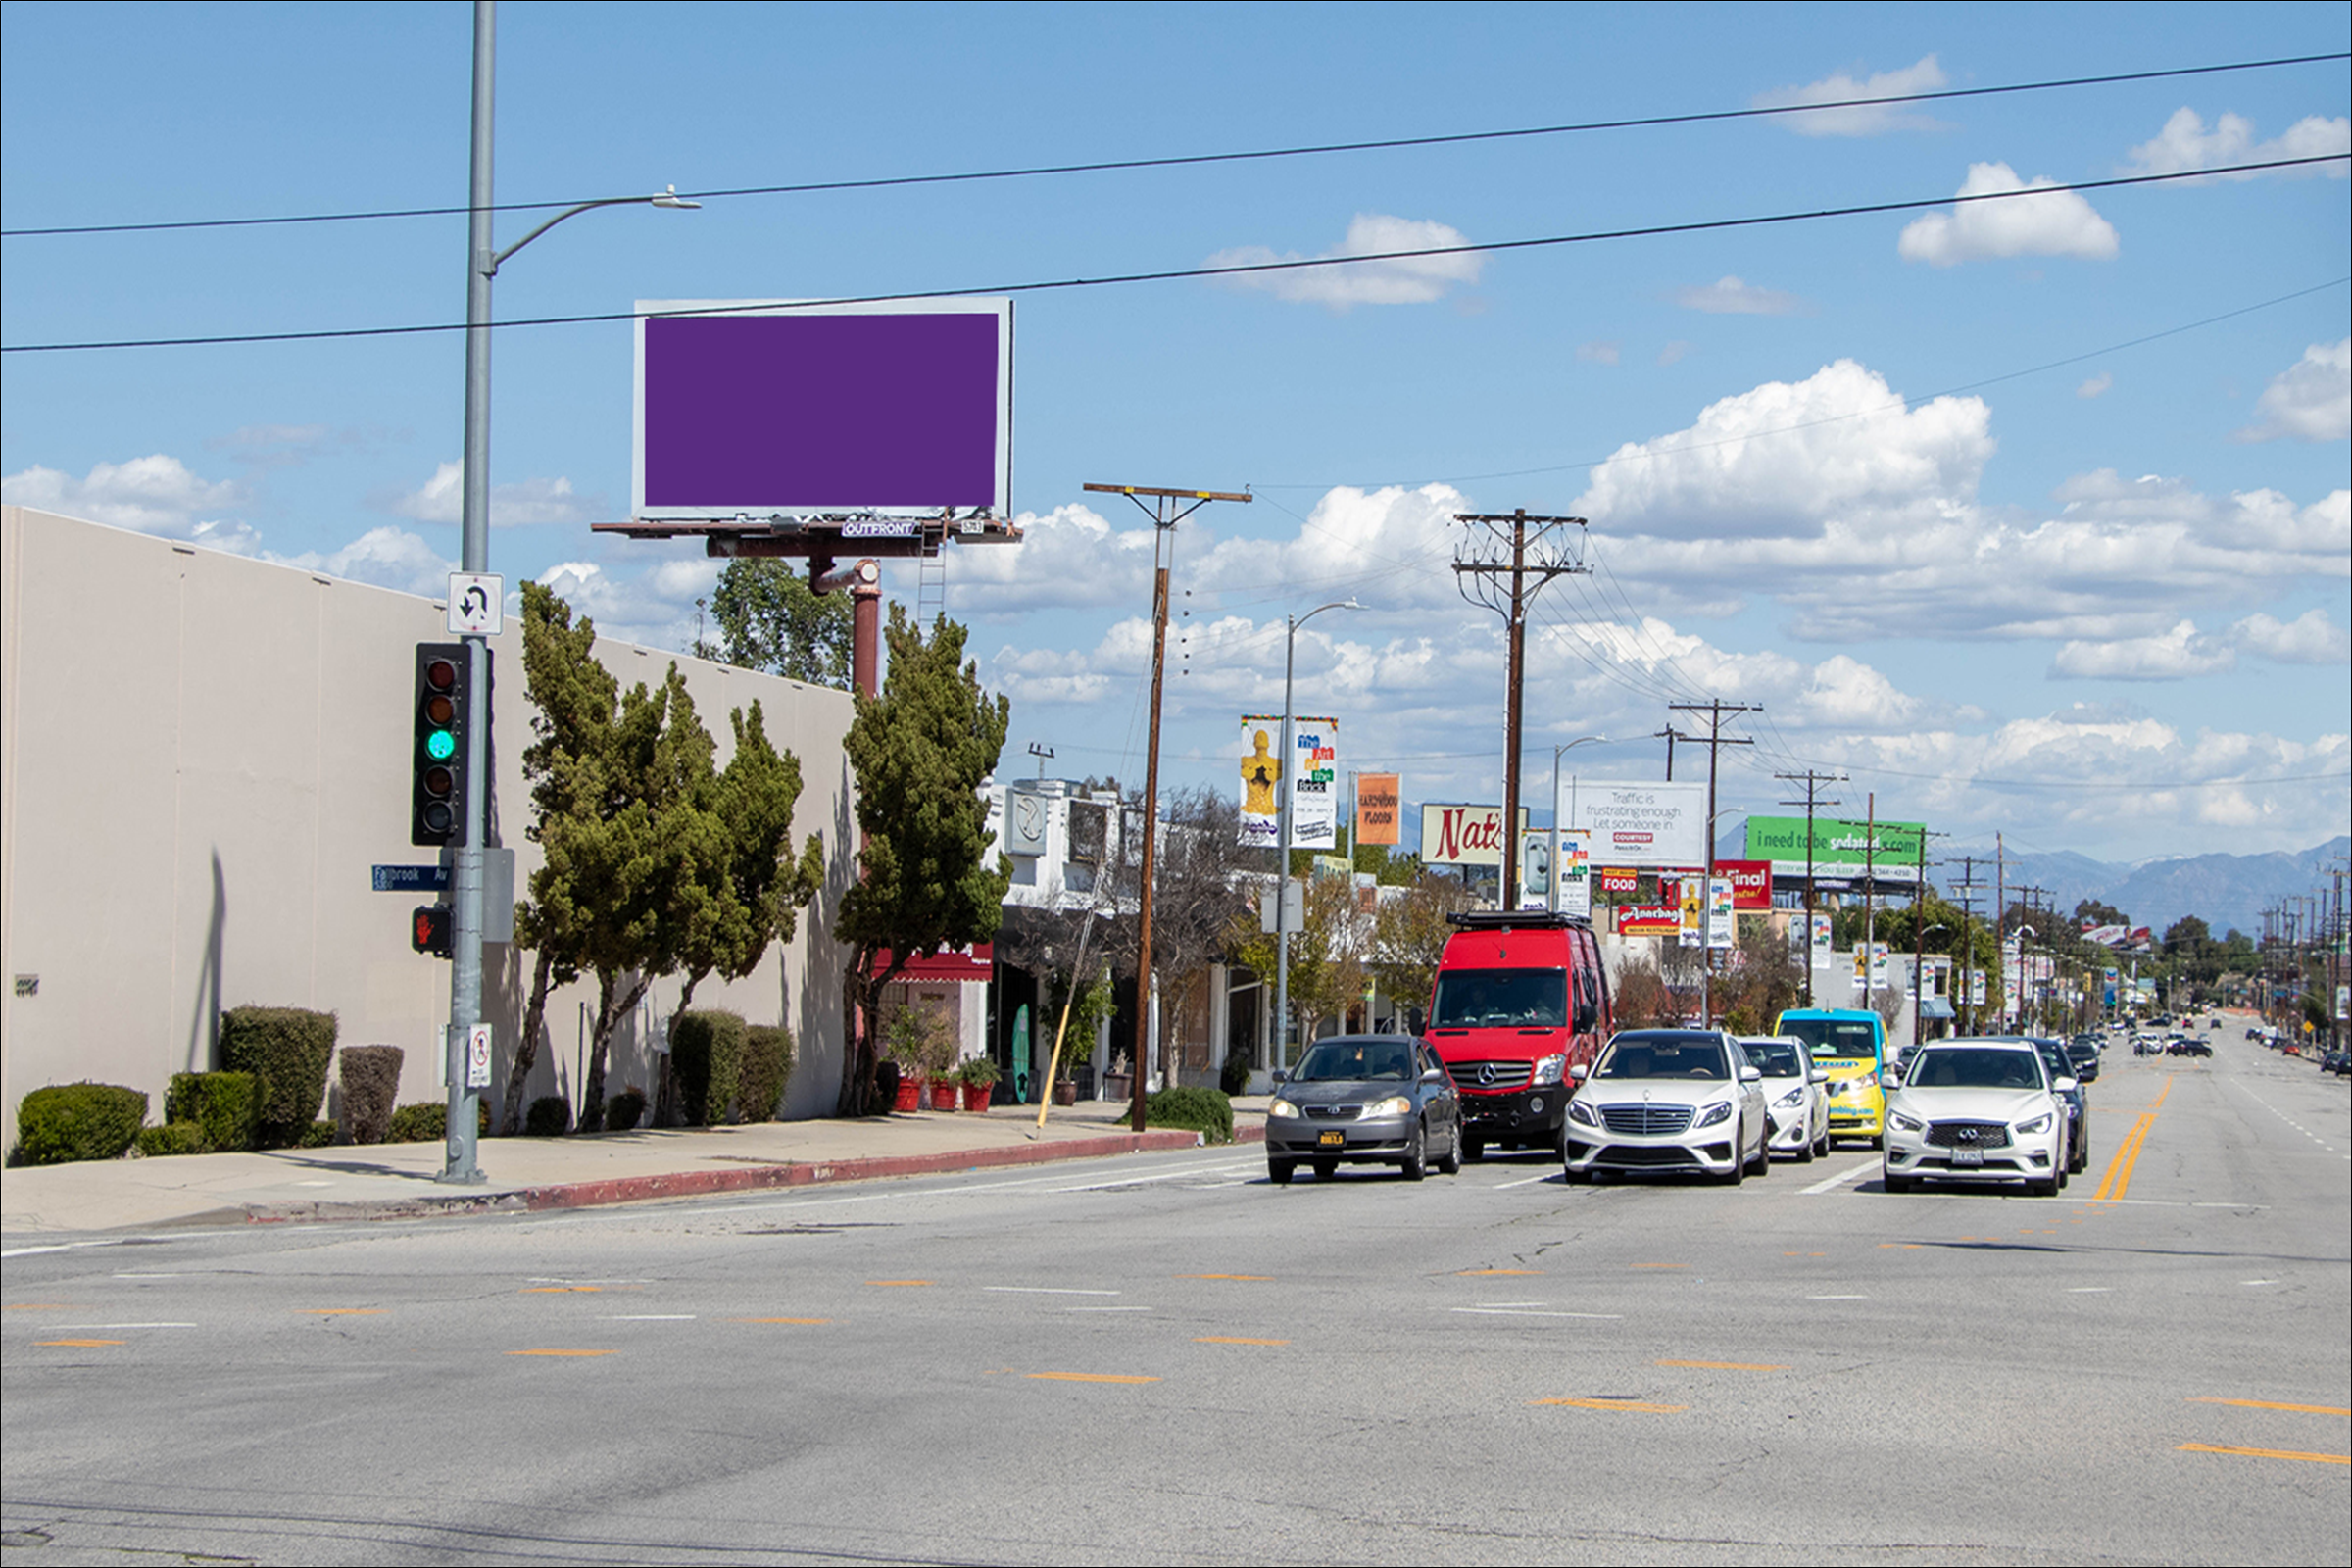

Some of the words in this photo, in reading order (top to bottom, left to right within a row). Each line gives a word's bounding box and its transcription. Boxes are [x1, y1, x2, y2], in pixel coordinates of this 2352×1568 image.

[845, 522, 914, 536] OUTFRONT
[1314, 748, 1333, 760] Art
[1313, 770, 1333, 782] the
[1612, 792, 1644, 804] Traffic
[1646, 792, 1655, 804] is
[1586, 805, 1640, 819] frustrating
[1593, 818, 1610, 829] Let
[1612, 819, 1662, 830] someone
[1757, 831, 1762, 846] i
[1764, 831, 1794, 848] need
[1813, 833, 1828, 850] be
[435, 868, 448, 880] Av
[1604, 878, 1636, 891] FOOD
